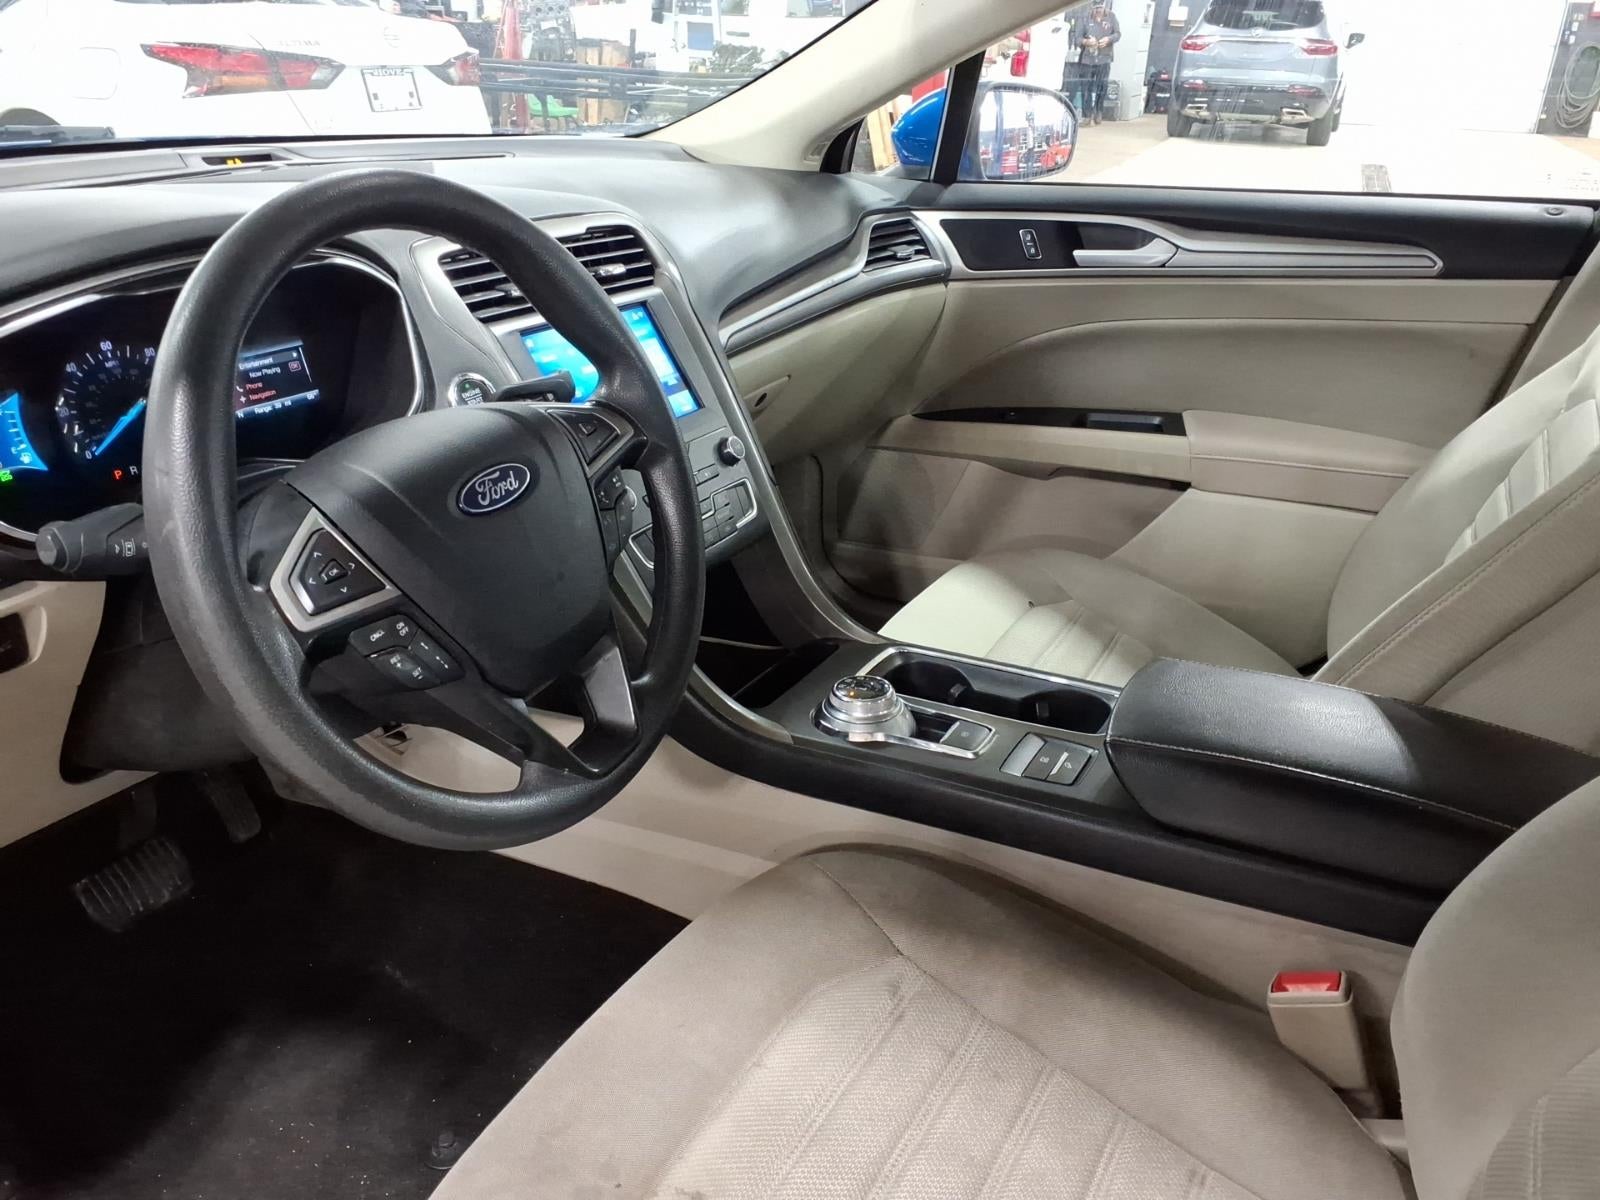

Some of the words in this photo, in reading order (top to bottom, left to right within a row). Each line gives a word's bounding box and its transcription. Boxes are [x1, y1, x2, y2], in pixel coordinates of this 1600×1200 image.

[100, 341, 112, 351] 60
[65, 362, 77, 373] 40
[114, 469, 123, 480] P
[130, 465, 139, 475] R
[475, 471, 519, 506] Ford
